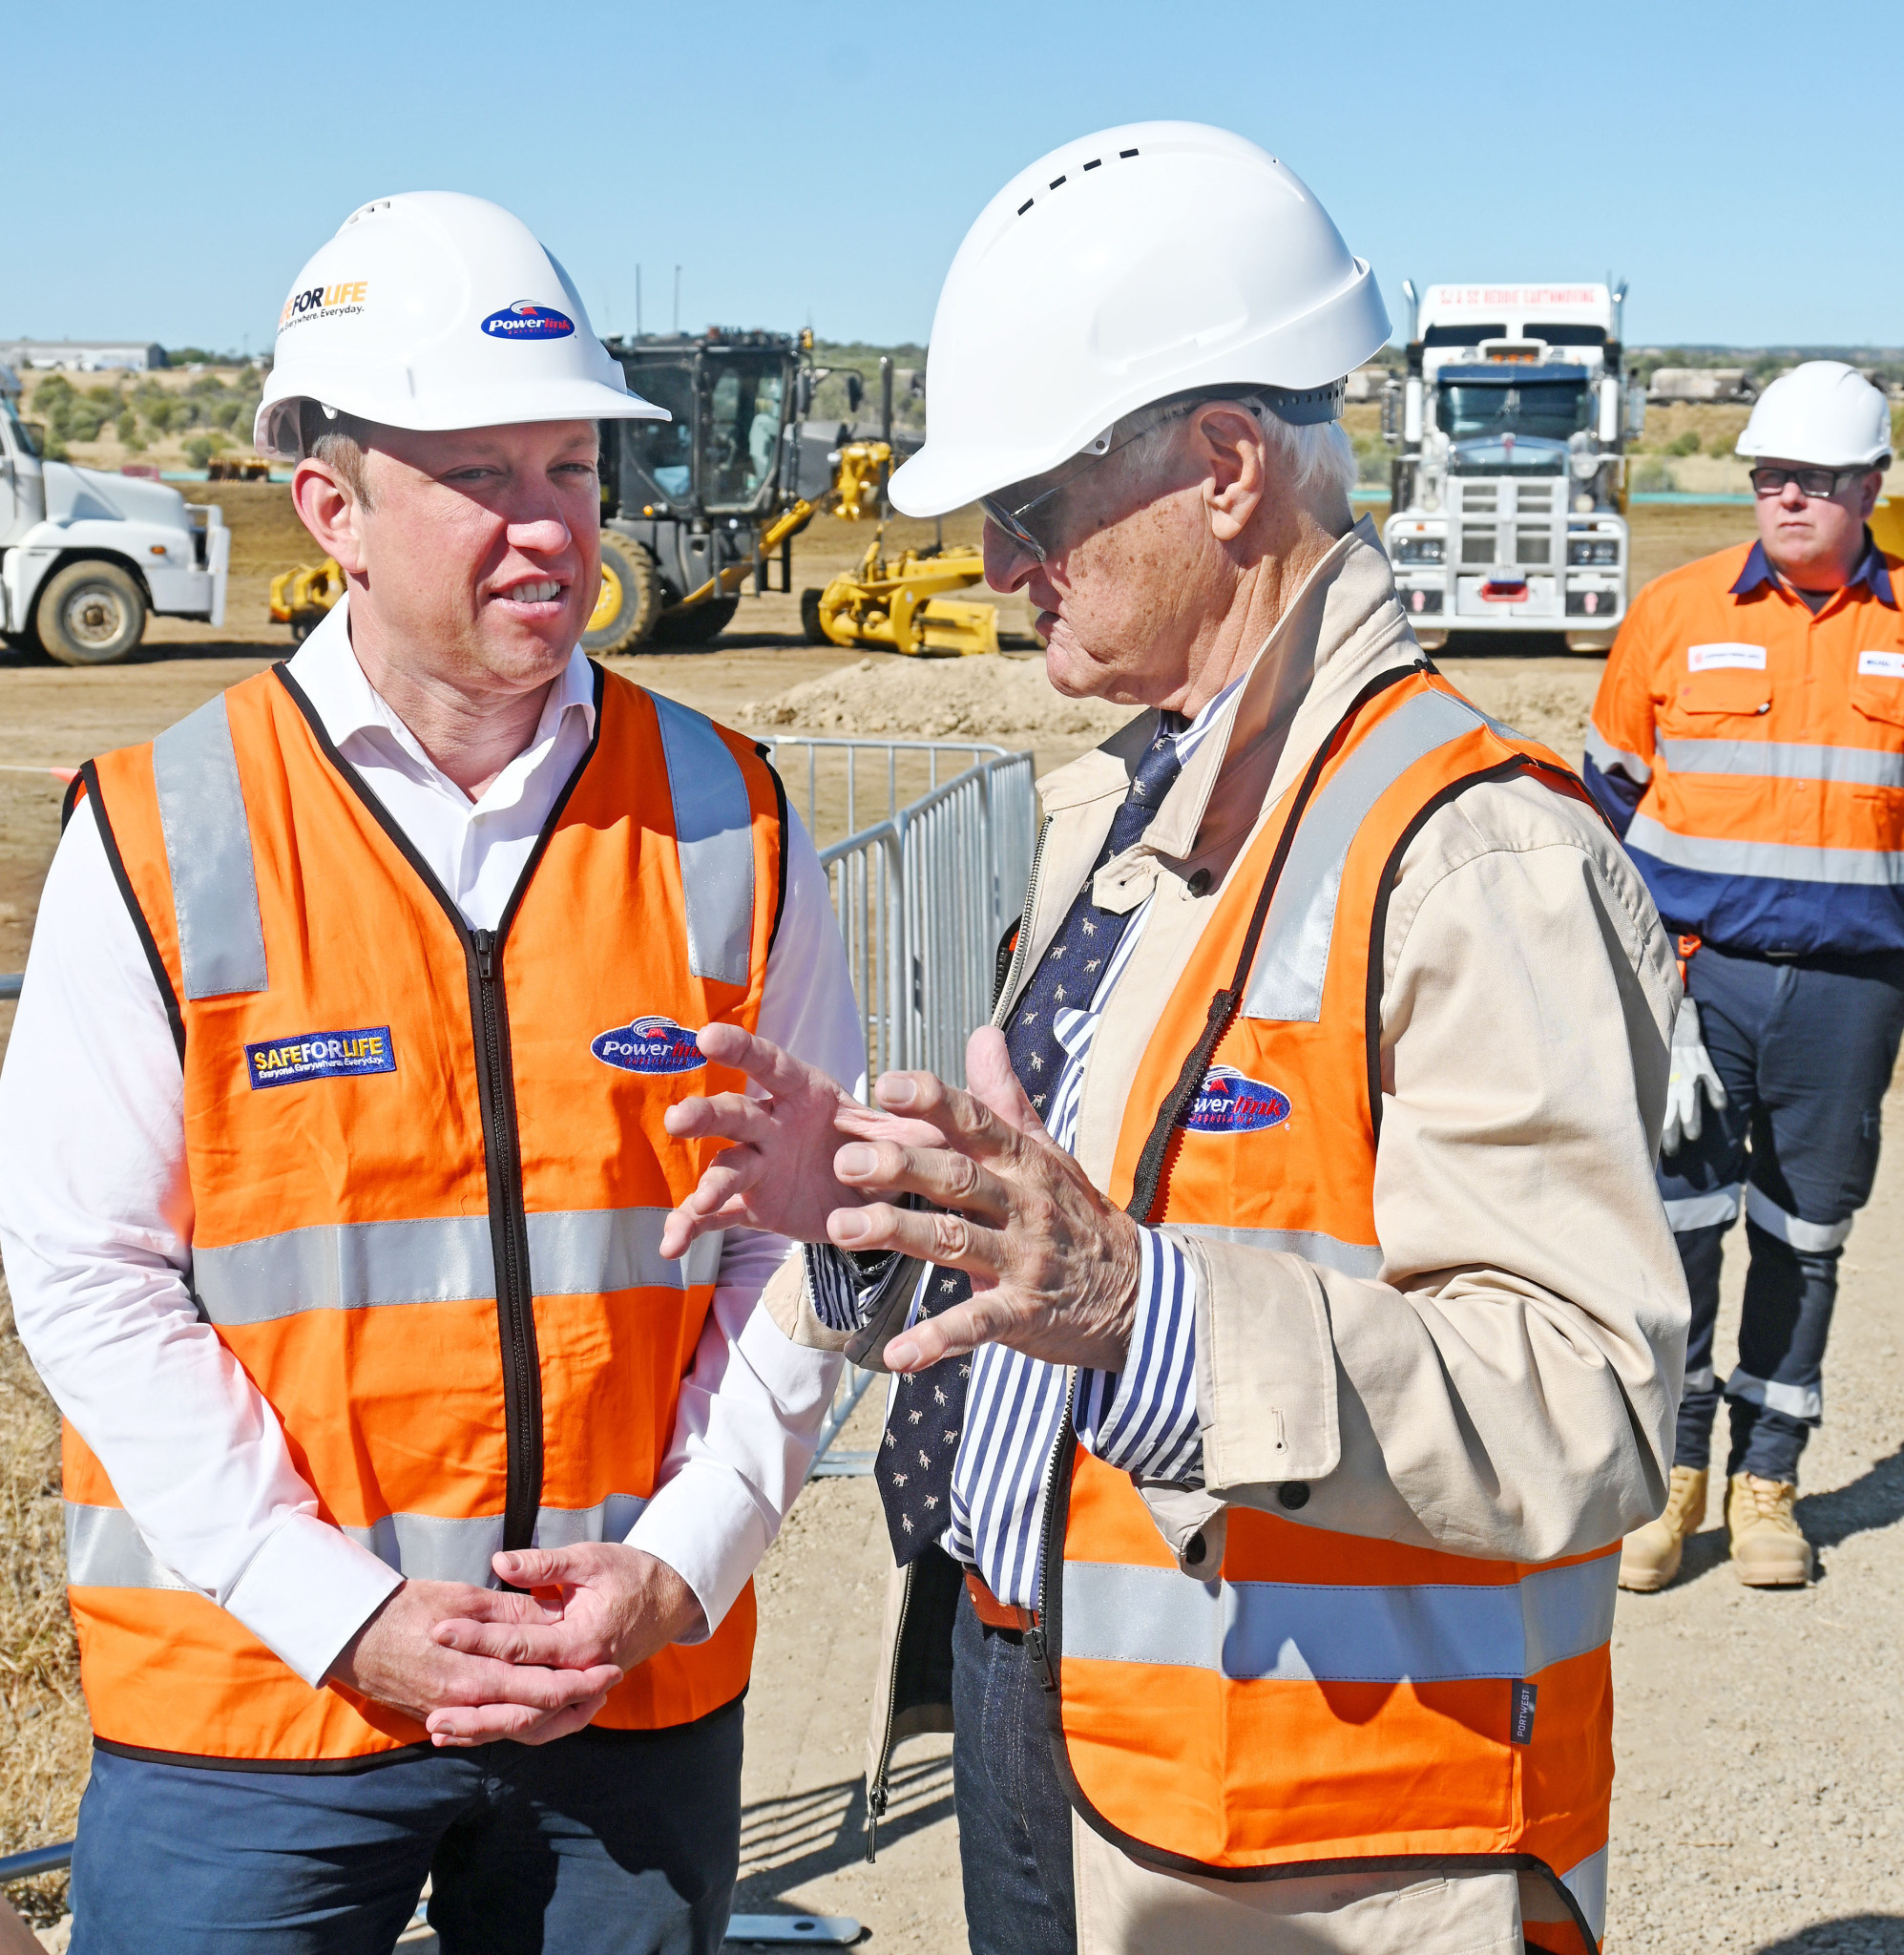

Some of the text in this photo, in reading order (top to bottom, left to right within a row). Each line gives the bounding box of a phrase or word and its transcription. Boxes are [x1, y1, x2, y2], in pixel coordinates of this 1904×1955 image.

[321, 305, 365, 318] Everyday.
[489, 318, 570, 331] Powerlink
[254, 1037, 384, 1070] SAFEFORLIFE
[602, 1039, 702, 1058] Powerlin
[1517, 1689, 1530, 1737] PORTWEST
